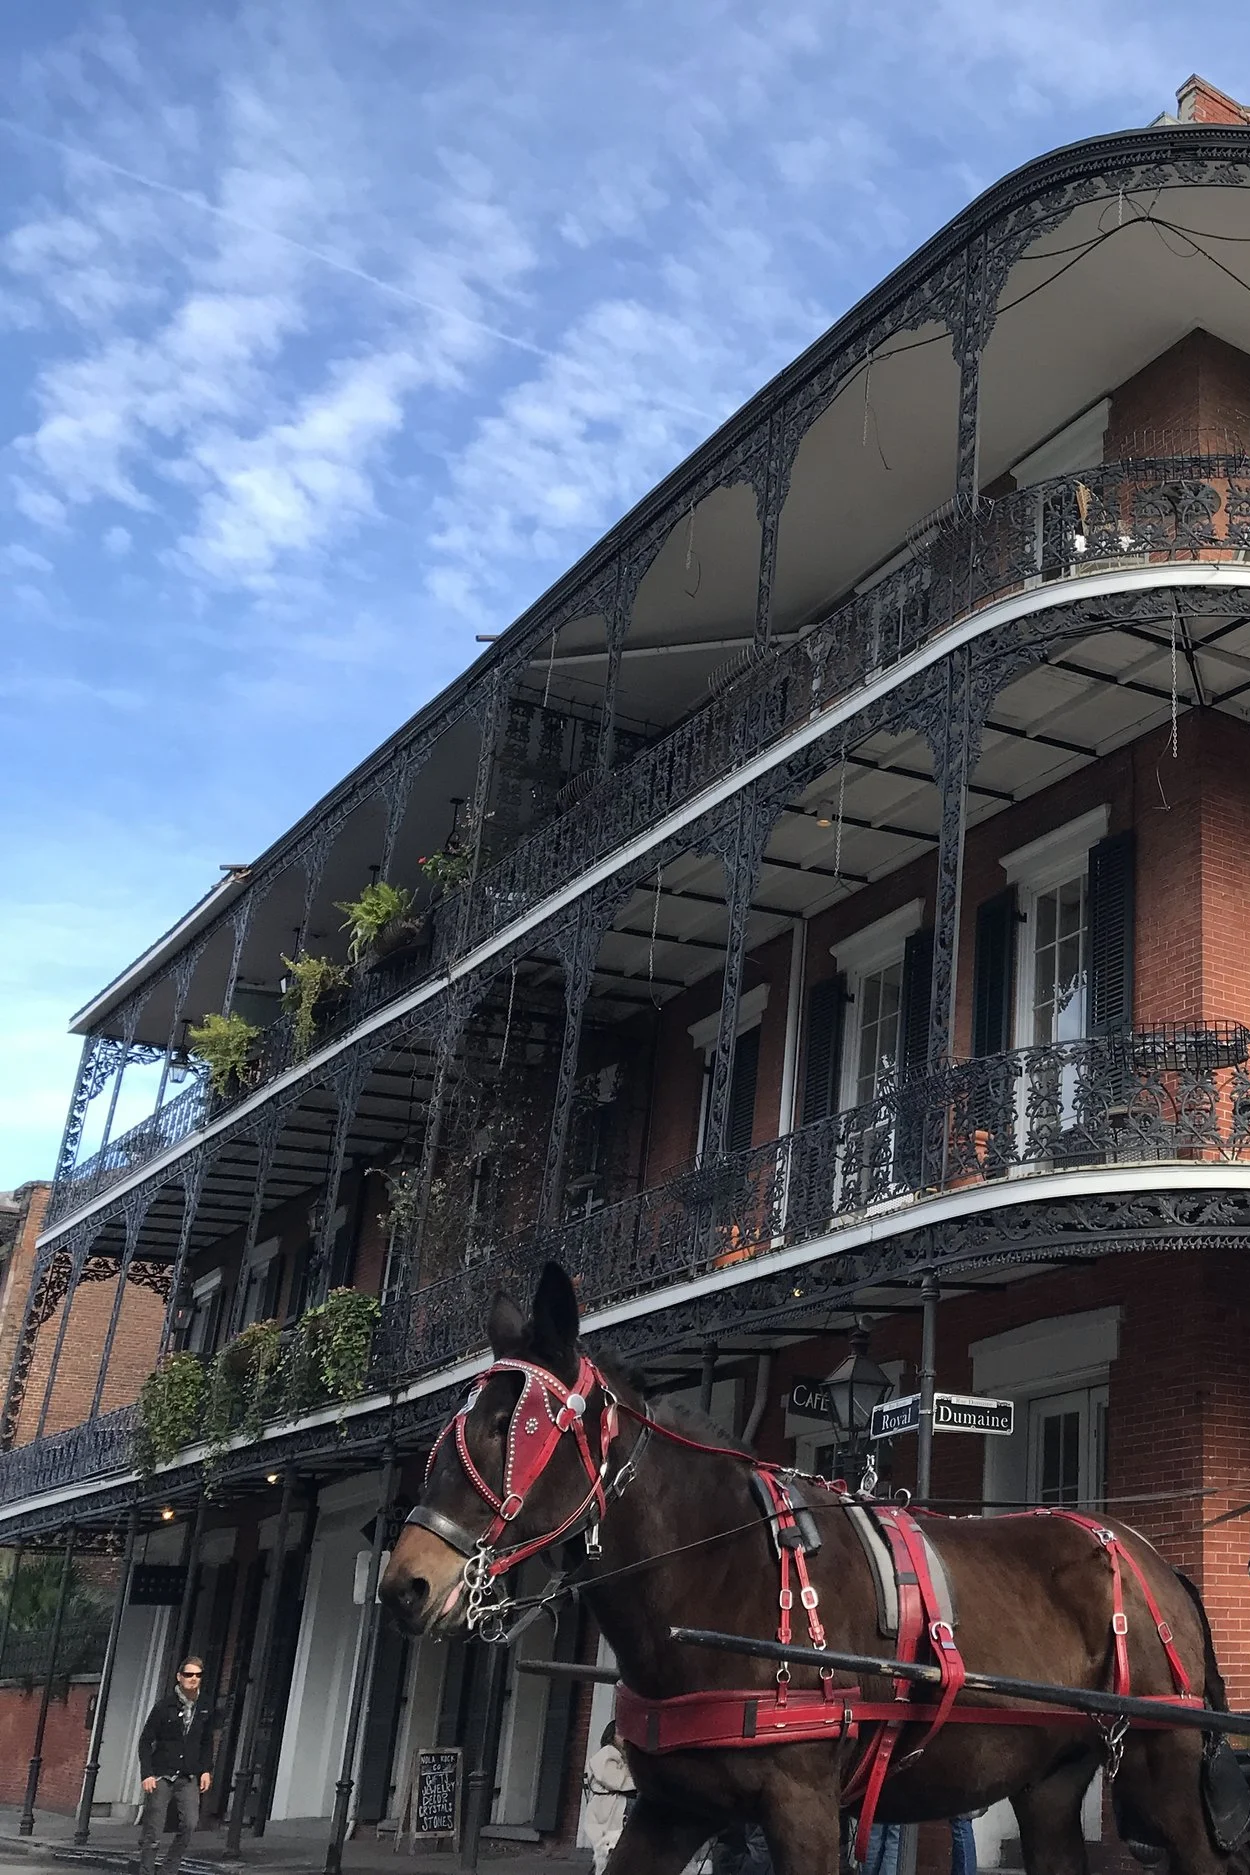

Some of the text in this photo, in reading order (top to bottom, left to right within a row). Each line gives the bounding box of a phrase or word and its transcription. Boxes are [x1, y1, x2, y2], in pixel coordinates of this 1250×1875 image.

[881, 1406, 912, 1431] Royal
[938, 1405, 1009, 1429] Dumaine
[421, 1781, 456, 1796] JEWELRY
[422, 1793, 449, 1806] DECOR
[418, 1802, 453, 1818] CRYSTALS
[421, 1815, 454, 1832] STONES
